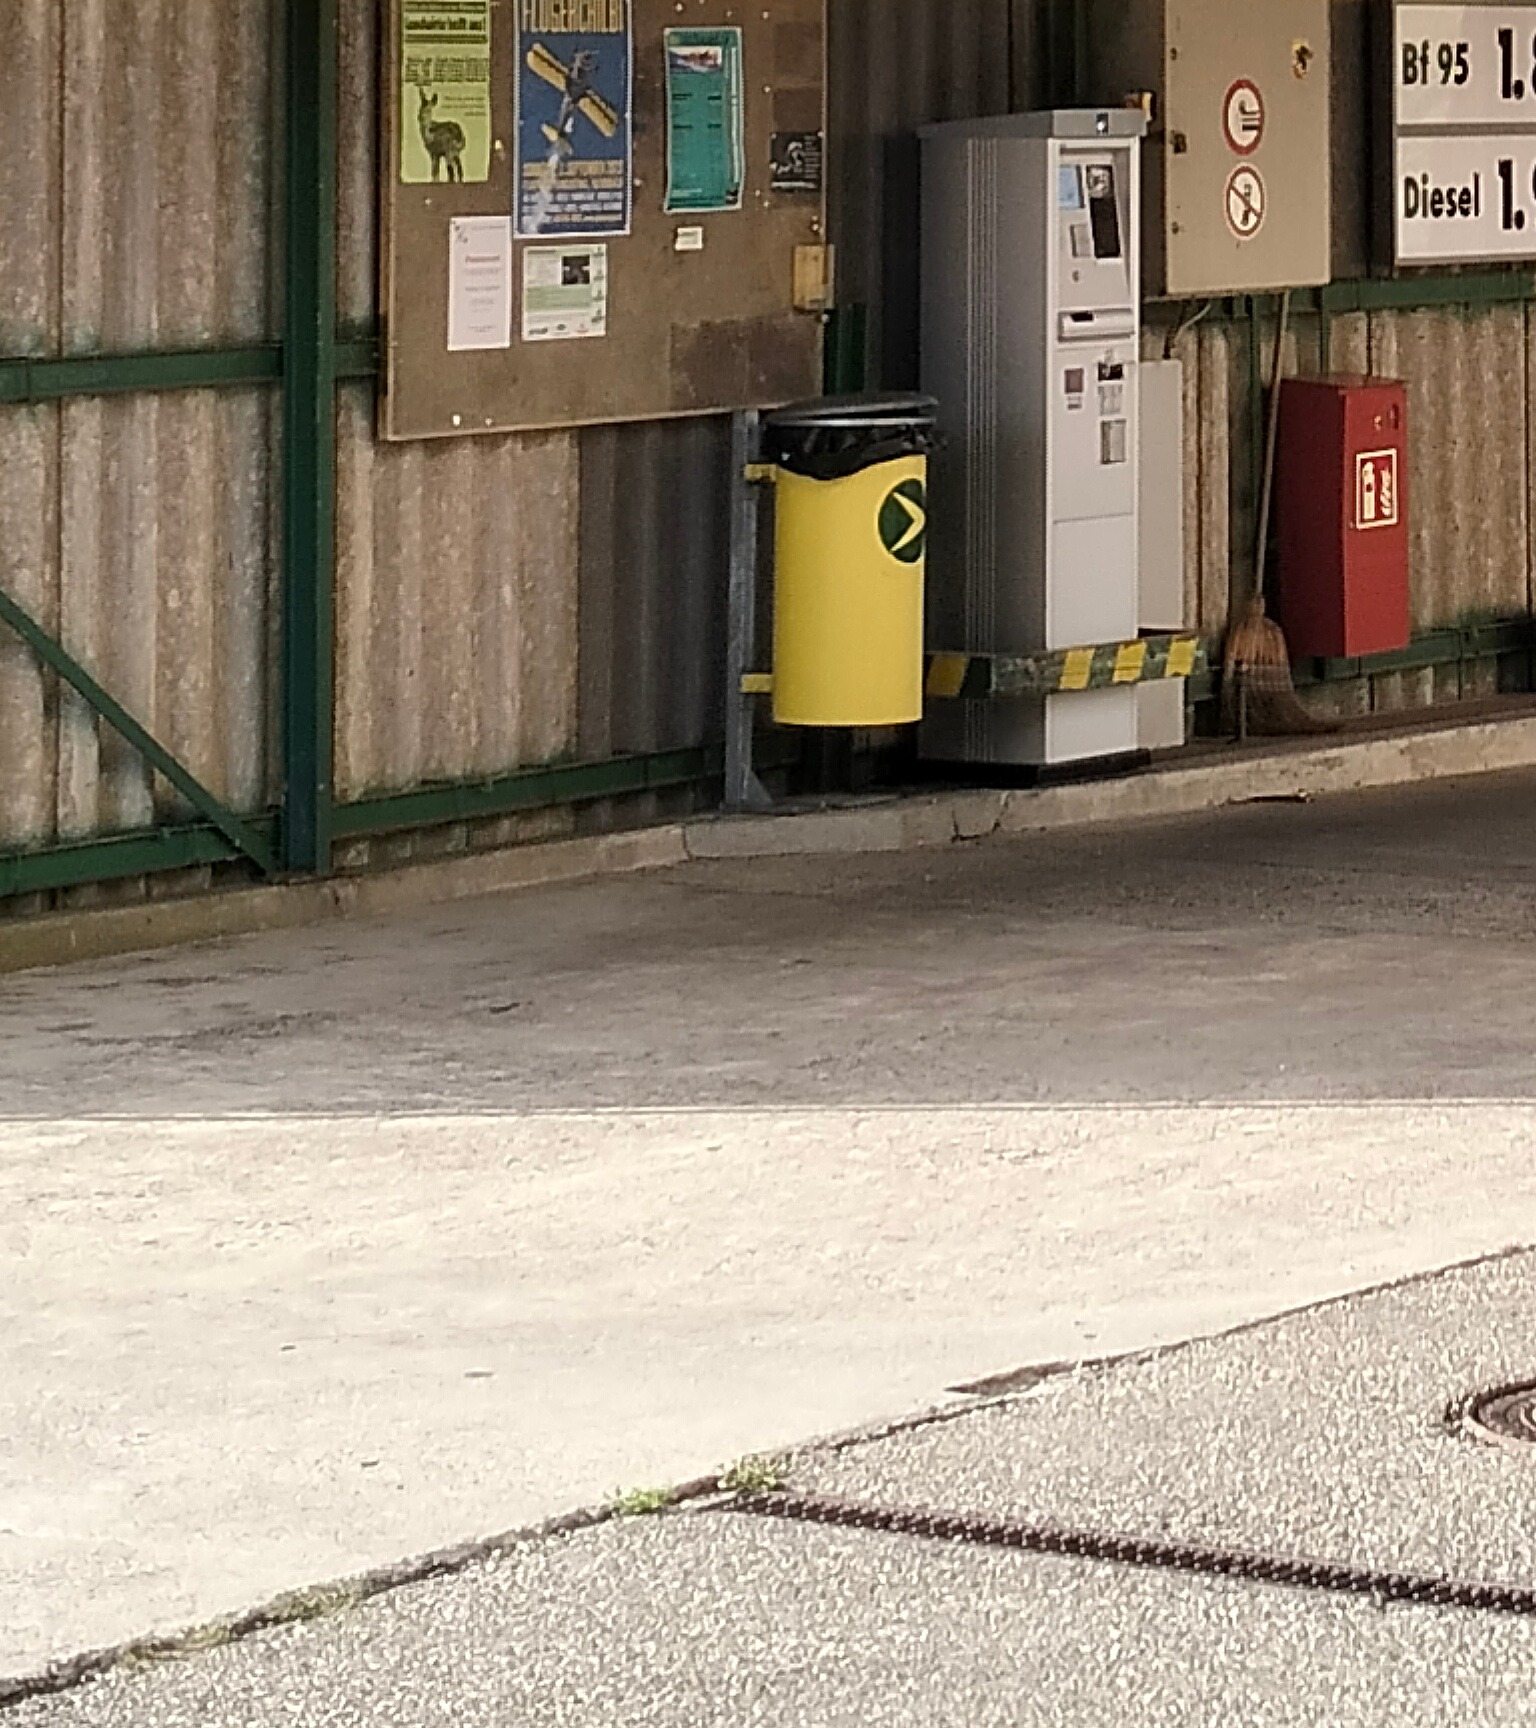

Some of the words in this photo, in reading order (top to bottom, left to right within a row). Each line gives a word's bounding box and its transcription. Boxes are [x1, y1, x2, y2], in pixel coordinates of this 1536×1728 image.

[1402, 39, 1430, 85] Bf
[1437, 42, 1469, 85] 95
[1404, 172, 1480, 219] Diesel
